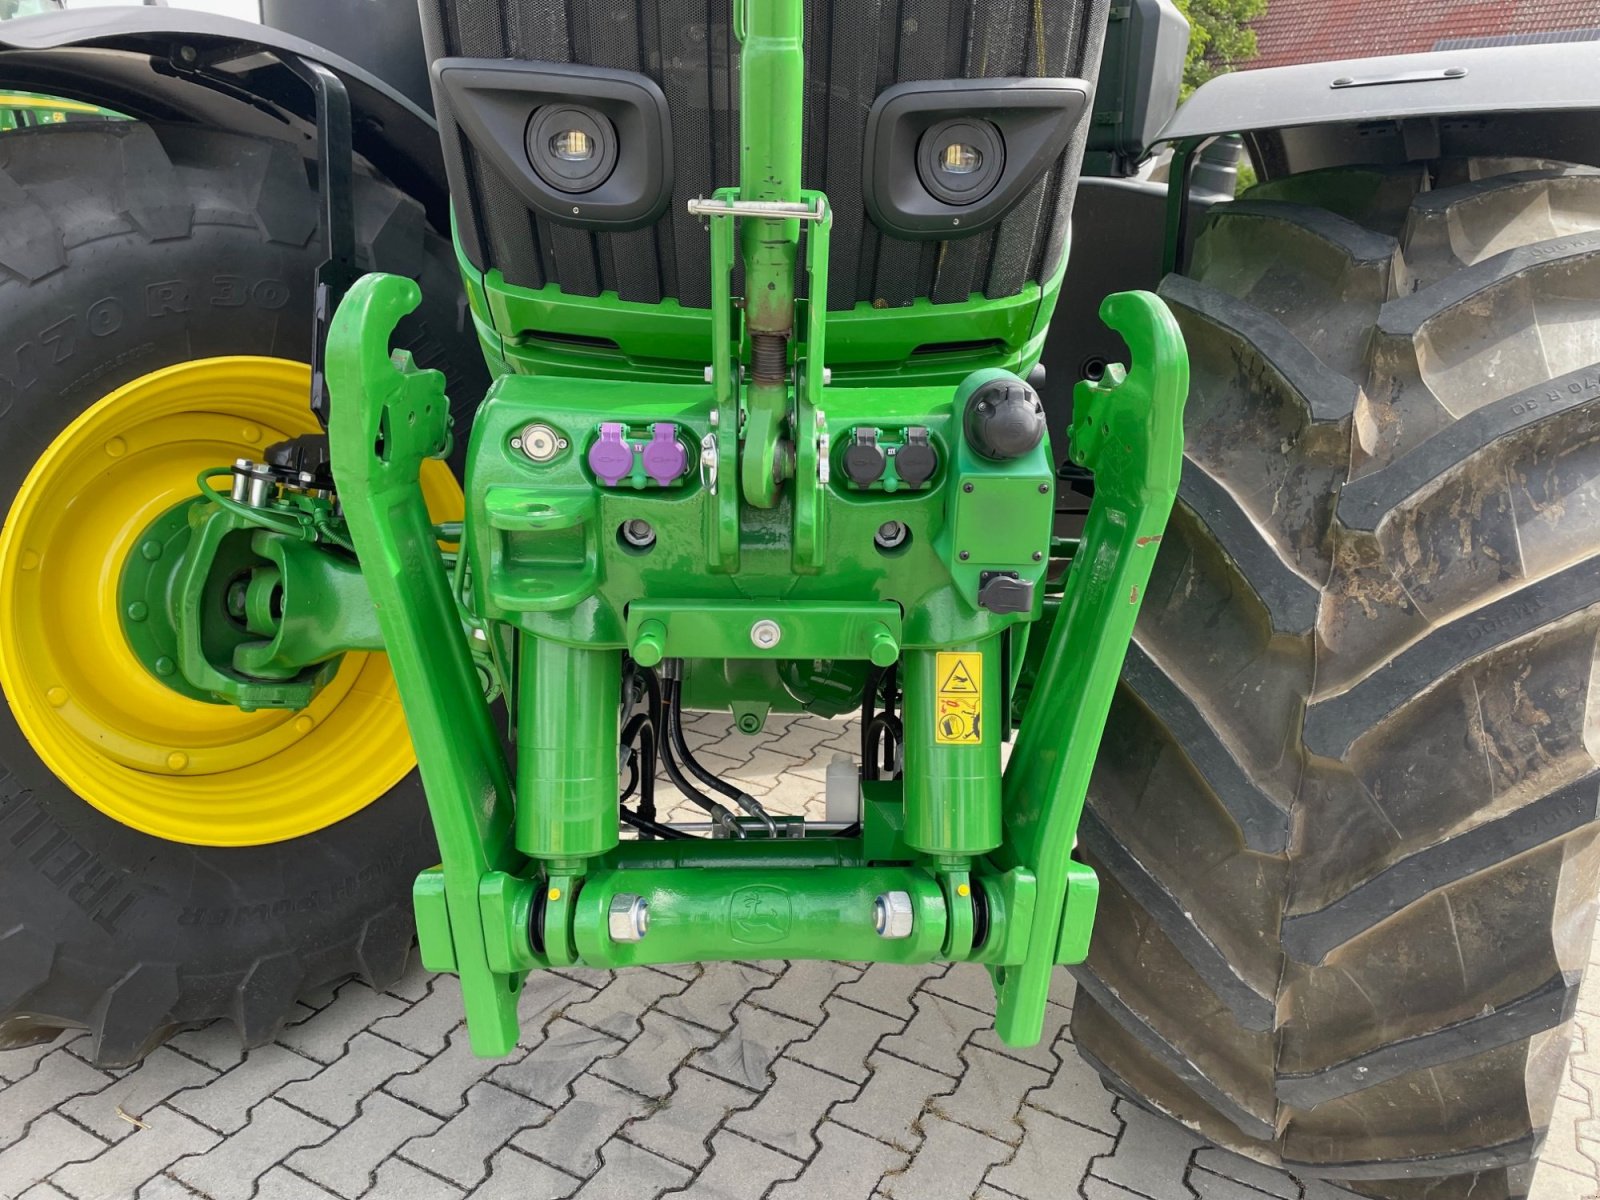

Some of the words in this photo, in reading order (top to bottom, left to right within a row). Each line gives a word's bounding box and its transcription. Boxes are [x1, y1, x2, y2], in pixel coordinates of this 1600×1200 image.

[144, 279, 193, 318] R
[209, 275, 291, 310] 30
[1511, 399, 1539, 417] 30
